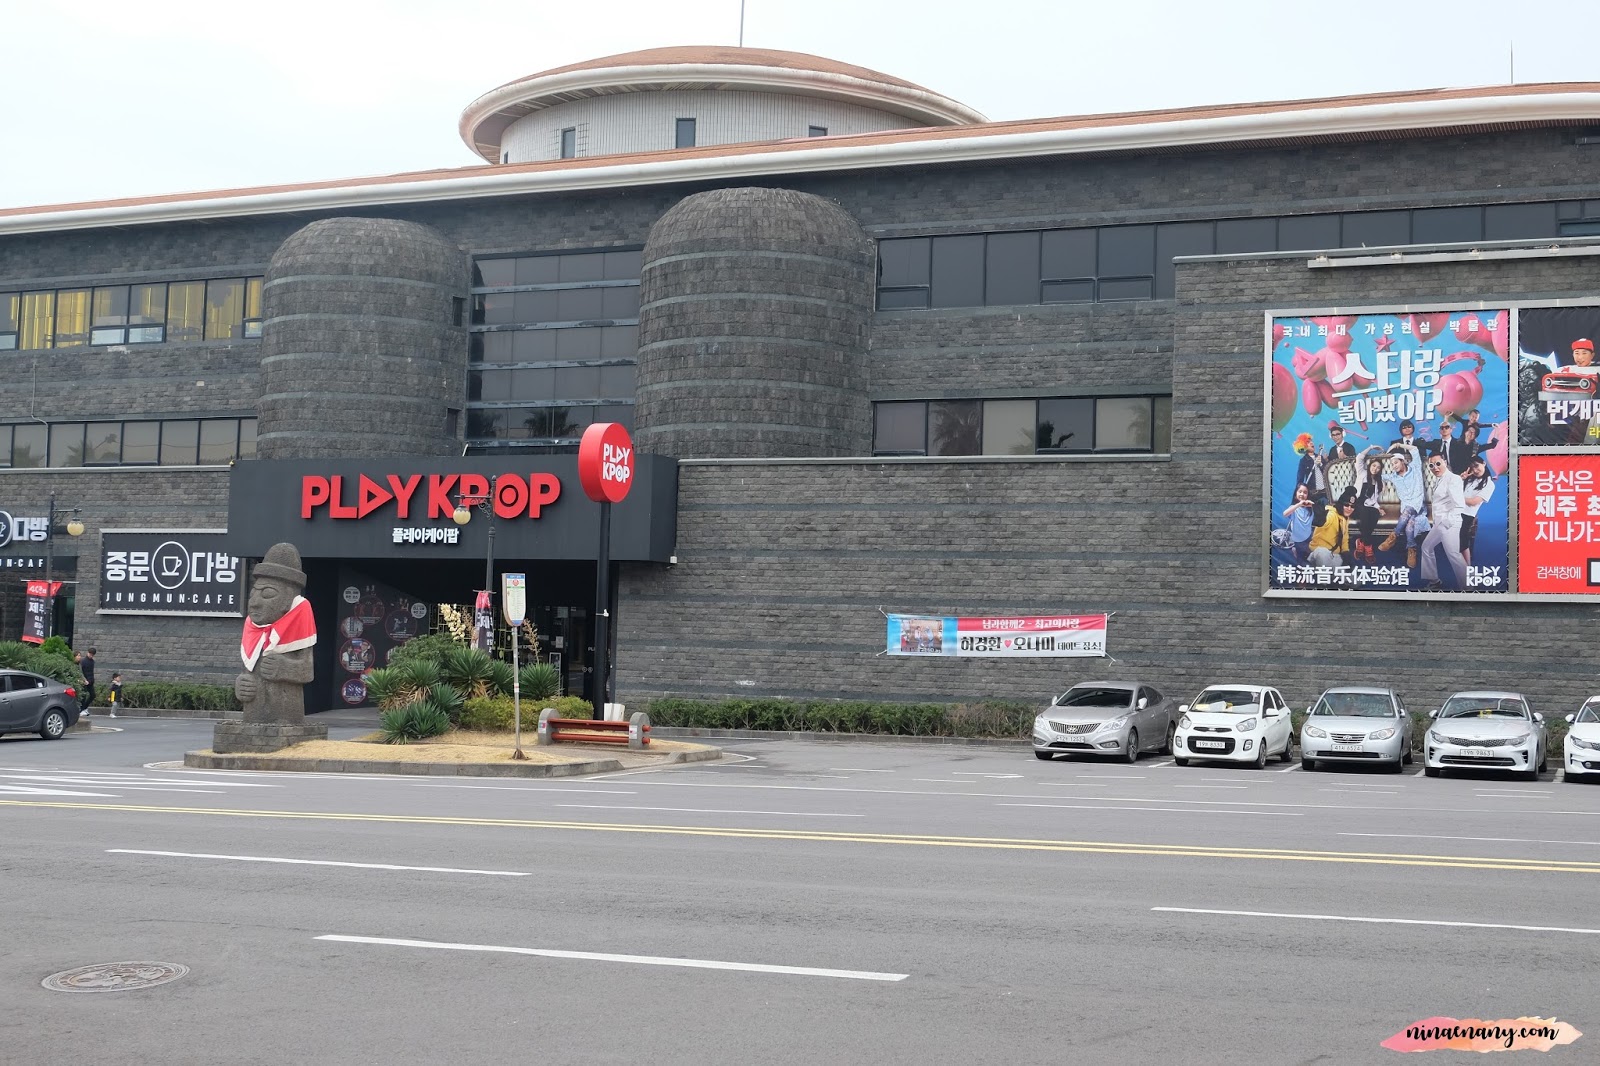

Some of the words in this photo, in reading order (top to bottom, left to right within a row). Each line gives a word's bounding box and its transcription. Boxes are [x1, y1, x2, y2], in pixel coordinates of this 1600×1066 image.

[1282, 323, 1346, 337] 국내최대
[1364, 320, 1431, 335] 가상현실
[1332, 349, 1444, 398] 스타랑
[1337, 389, 1443, 424] 놀아봤어?
[604, 443, 631, 466] PLAY
[602, 461, 630, 484] KPOP
[1535, 470, 1593, 492] 당신은
[301, 473, 423, 519] PLAY
[427, 473, 561, 519] KPOP
[1534, 495, 1578, 517] 제주
[12, 516, 49, 541] 다방
[392, 527, 460, 544] 플레이케이팝
[106, 551, 150, 582] 중문
[190, 552, 240, 583] 다방
[1277, 564, 1410, 586] 韩流音乐体验馆
[1466, 566, 1500, 577] PLAY
[1537, 566, 1581, 580] 검색창에
[1466, 576, 1501, 587] KPOP
[960, 636, 1002, 652] 허경환
[1013, 636, 1055, 651] 오나미
